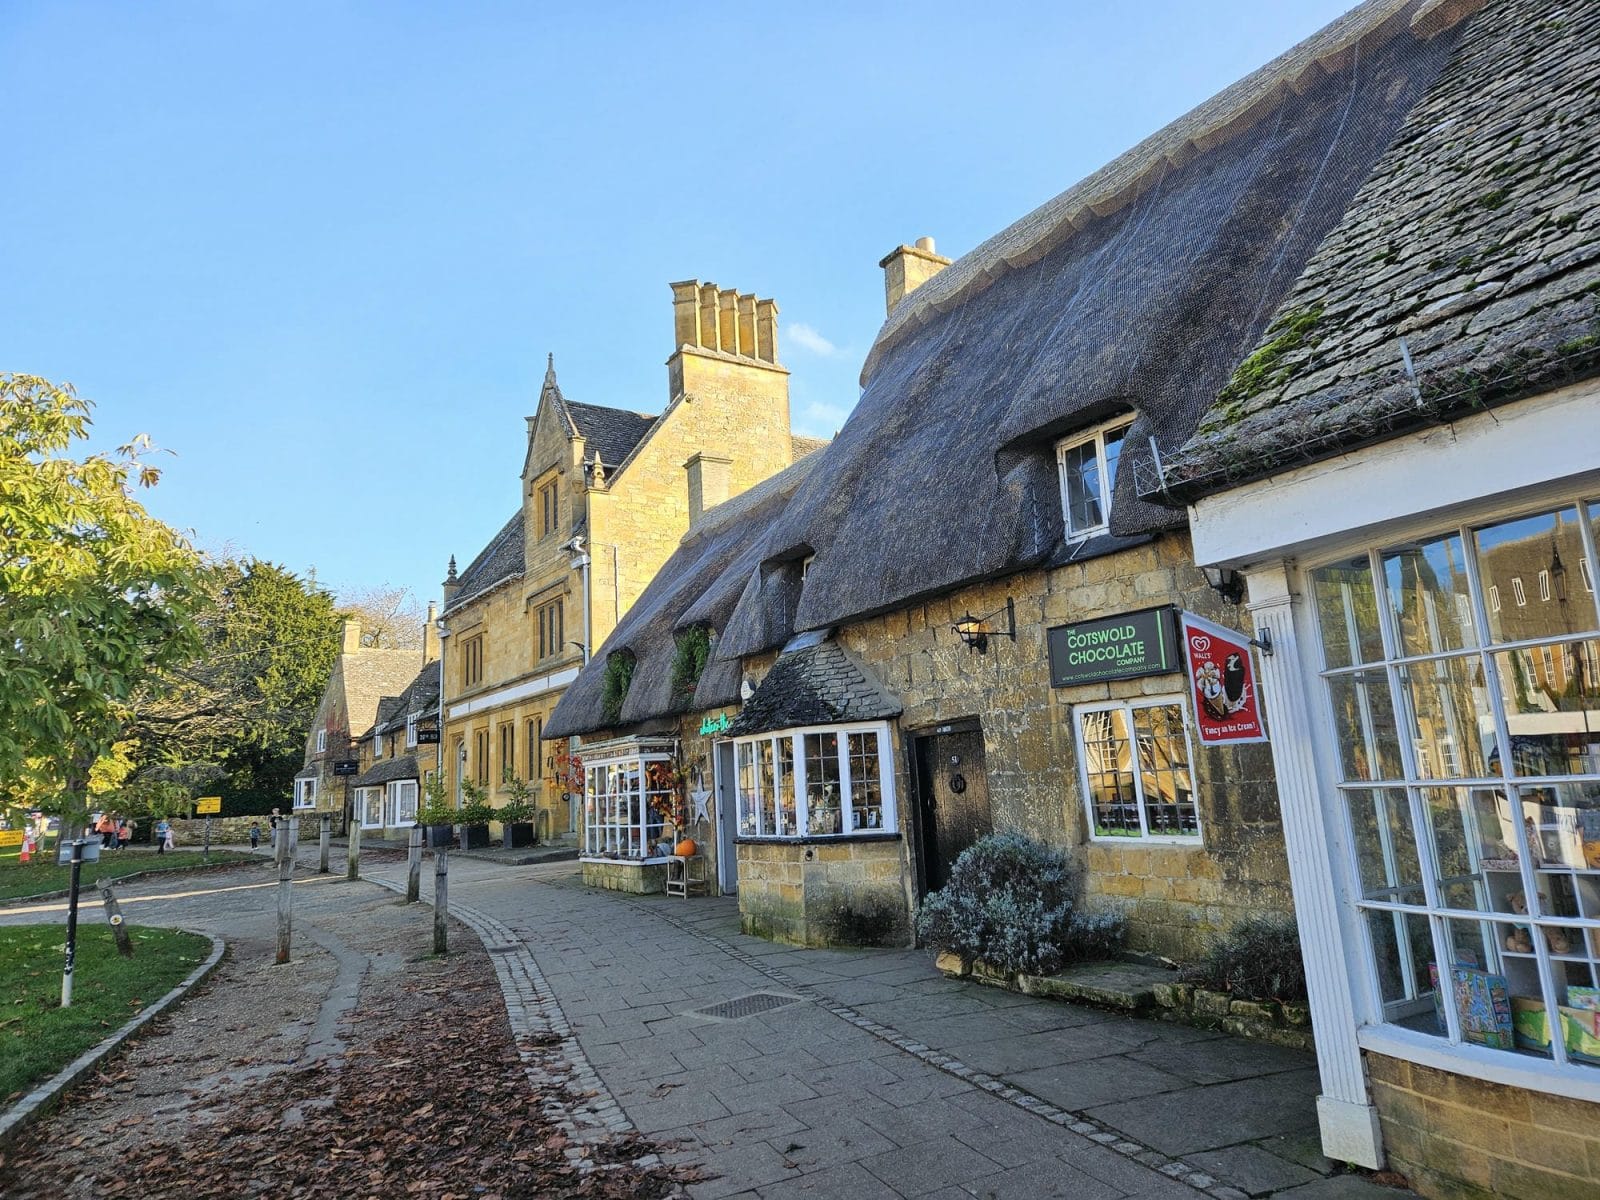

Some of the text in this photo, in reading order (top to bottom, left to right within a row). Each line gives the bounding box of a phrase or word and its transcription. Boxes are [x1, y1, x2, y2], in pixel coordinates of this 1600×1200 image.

[1067, 625, 1136, 649] COTSWOLD
[1069, 641, 1145, 665] CHOCOLATE
[1116, 656, 1145, 666] COMPANY
[1205, 727, 1221, 736] Fancy
[1228, 724, 1237, 732] Ice
